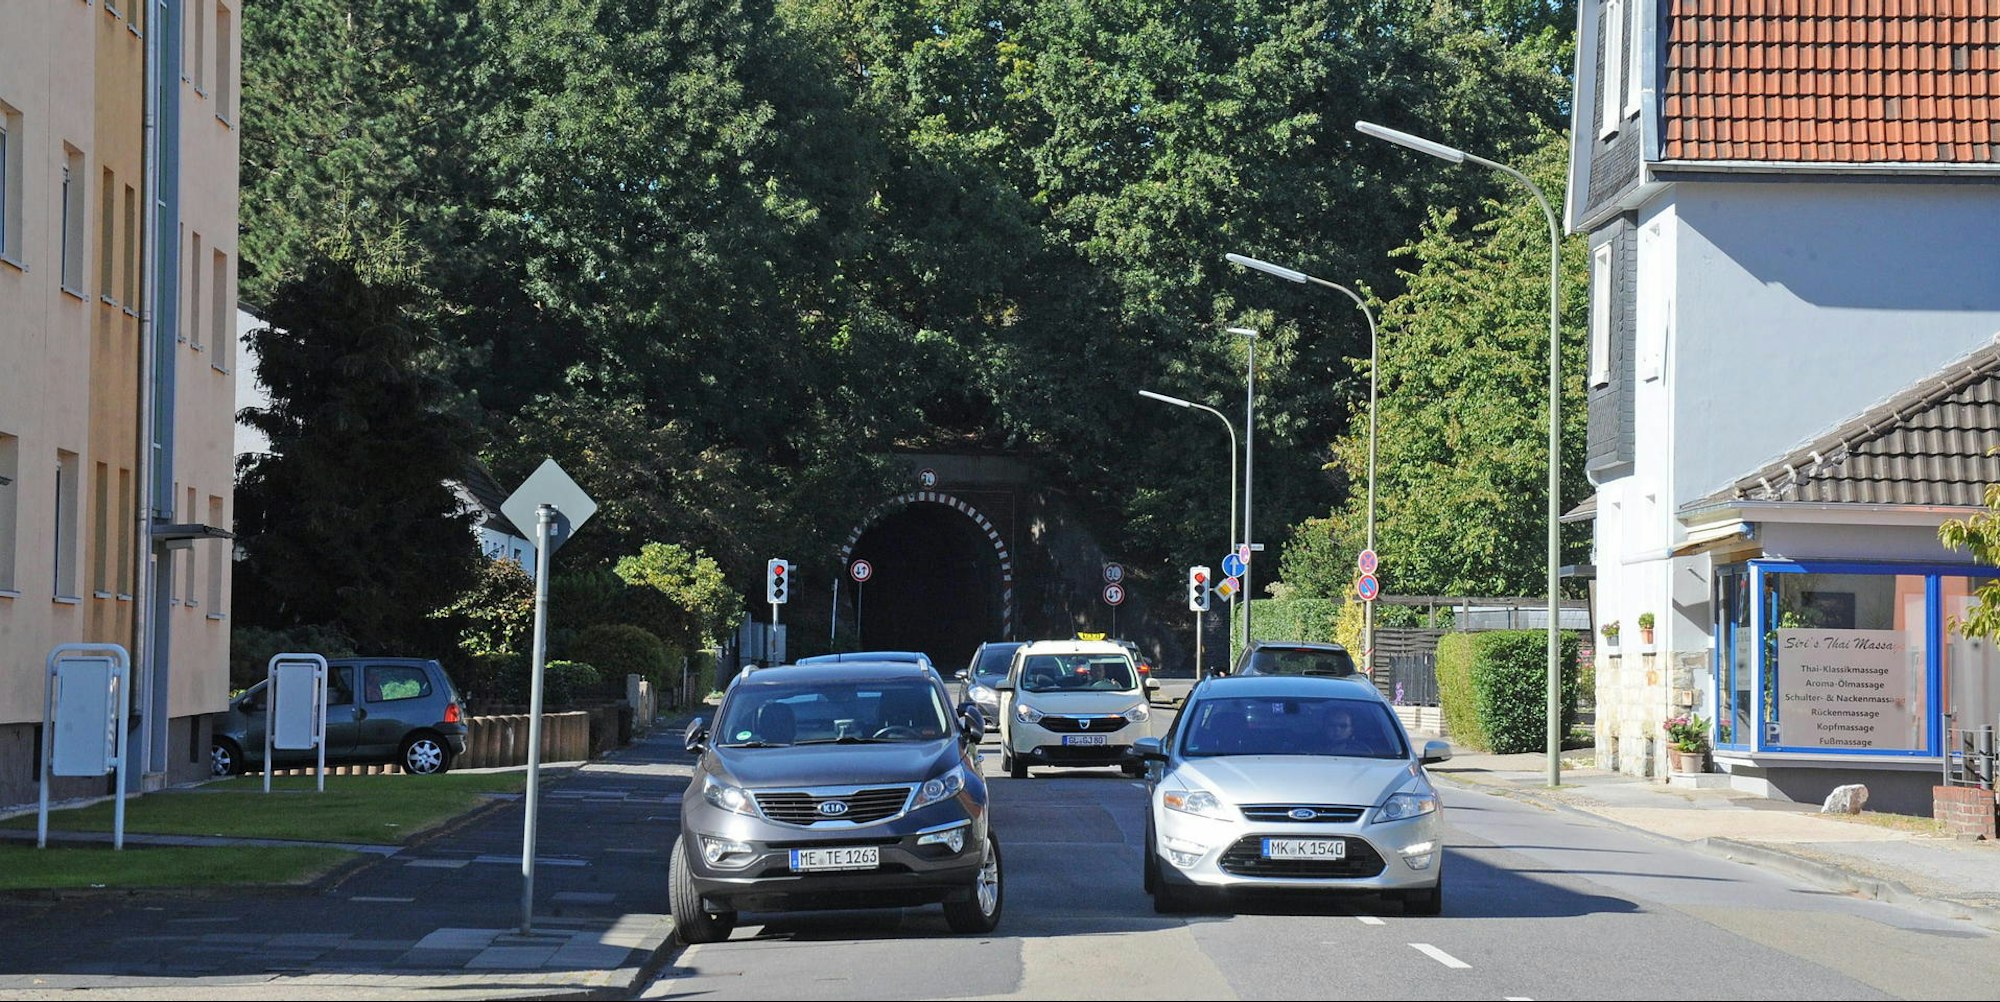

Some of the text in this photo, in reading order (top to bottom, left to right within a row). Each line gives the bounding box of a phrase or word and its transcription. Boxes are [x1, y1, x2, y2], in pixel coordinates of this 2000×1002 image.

[1784, 637, 1819, 650] Siri's
[1823, 637, 1849, 650] Thai
[1801, 664, 1889, 676] Thai-Klassikmassage
[1785, 693, 1824, 702] Schulter-
[1826, 694, 1834, 702] &
[1811, 708, 1880, 719] Rückenmassage
[1817, 723, 1875, 734] Kopfmassage
[1819, 737, 1873, 748] Fußmassage
[823, 804, 843, 813] KIA
[1271, 841, 1343, 855] MK K 1540
[801, 849, 877, 866] ME TE 1263
